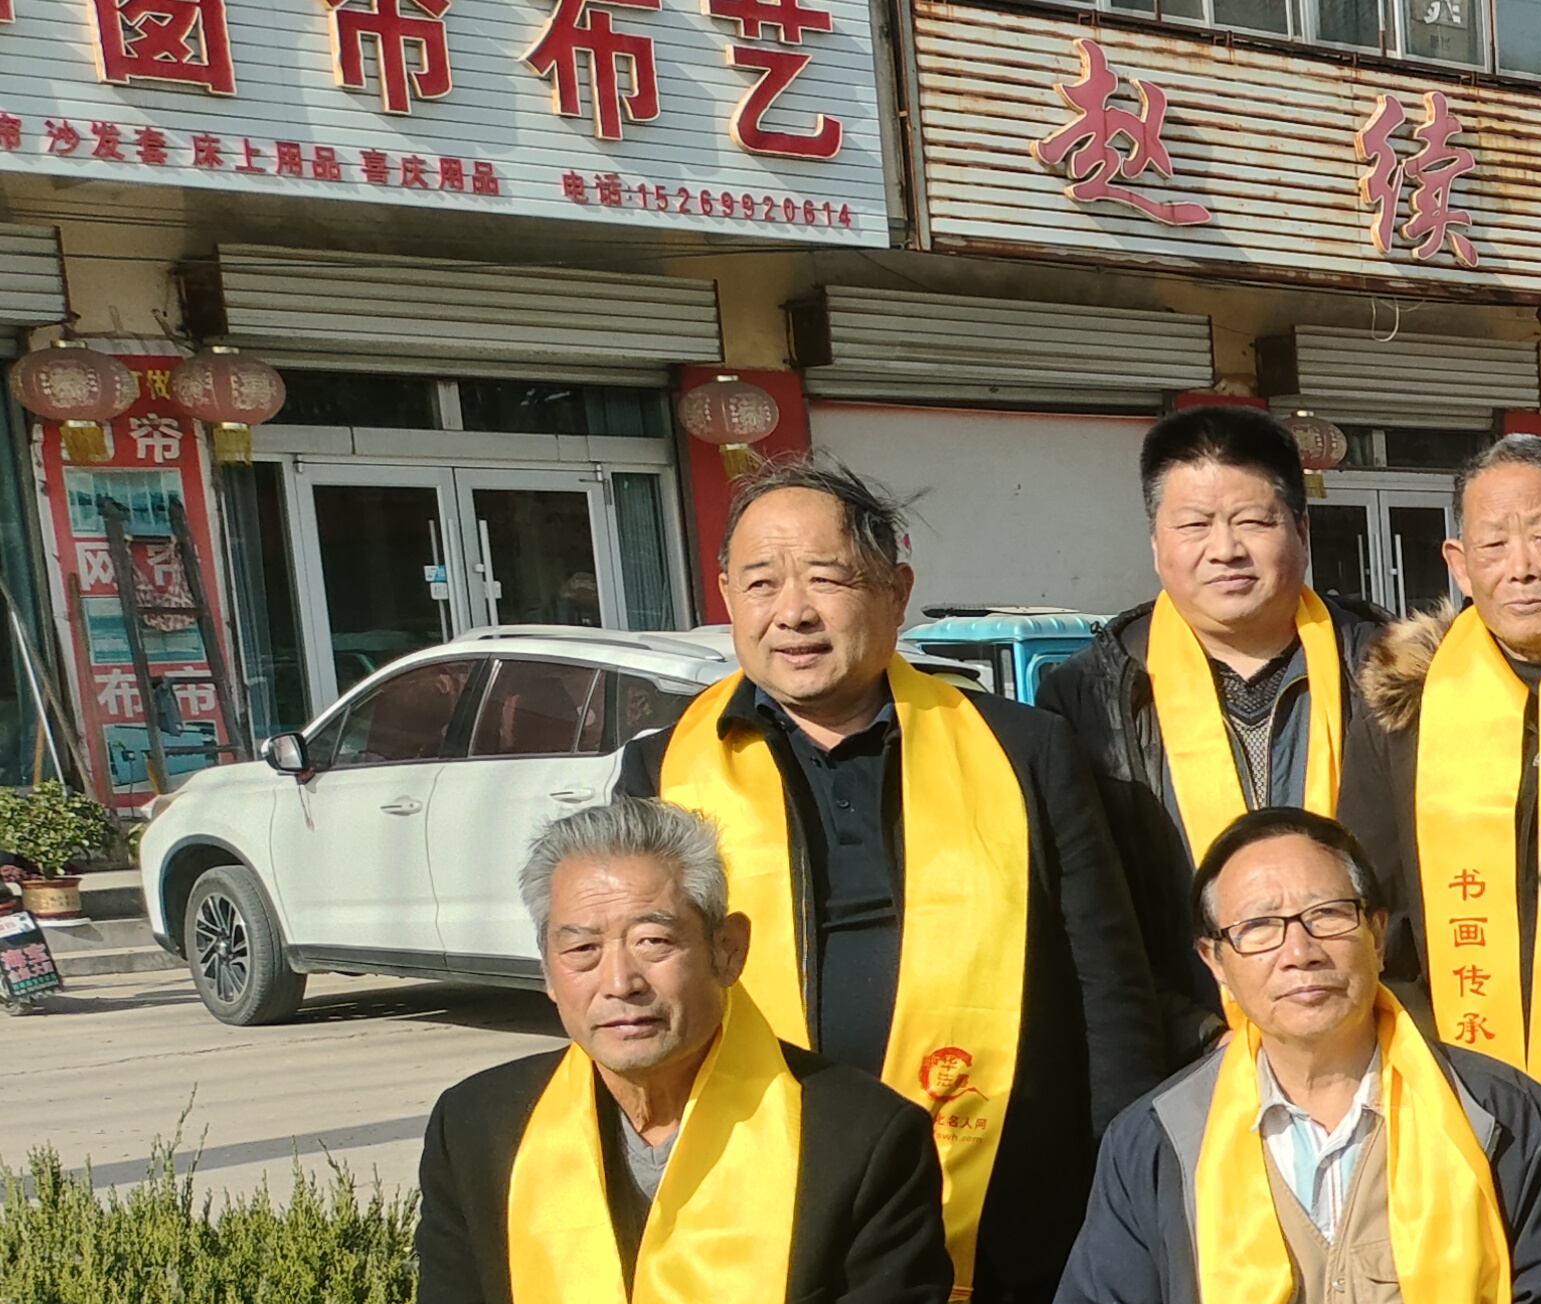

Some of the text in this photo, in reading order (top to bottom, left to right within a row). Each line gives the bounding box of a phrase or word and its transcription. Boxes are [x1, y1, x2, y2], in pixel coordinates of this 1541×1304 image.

[45, 118, 168, 166] 沙发套
[191, 132, 343, 182] 床上用品
[359, 148, 500, 196] 喜庆用品
[1448, 868, 1496, 1044] 书画传承
